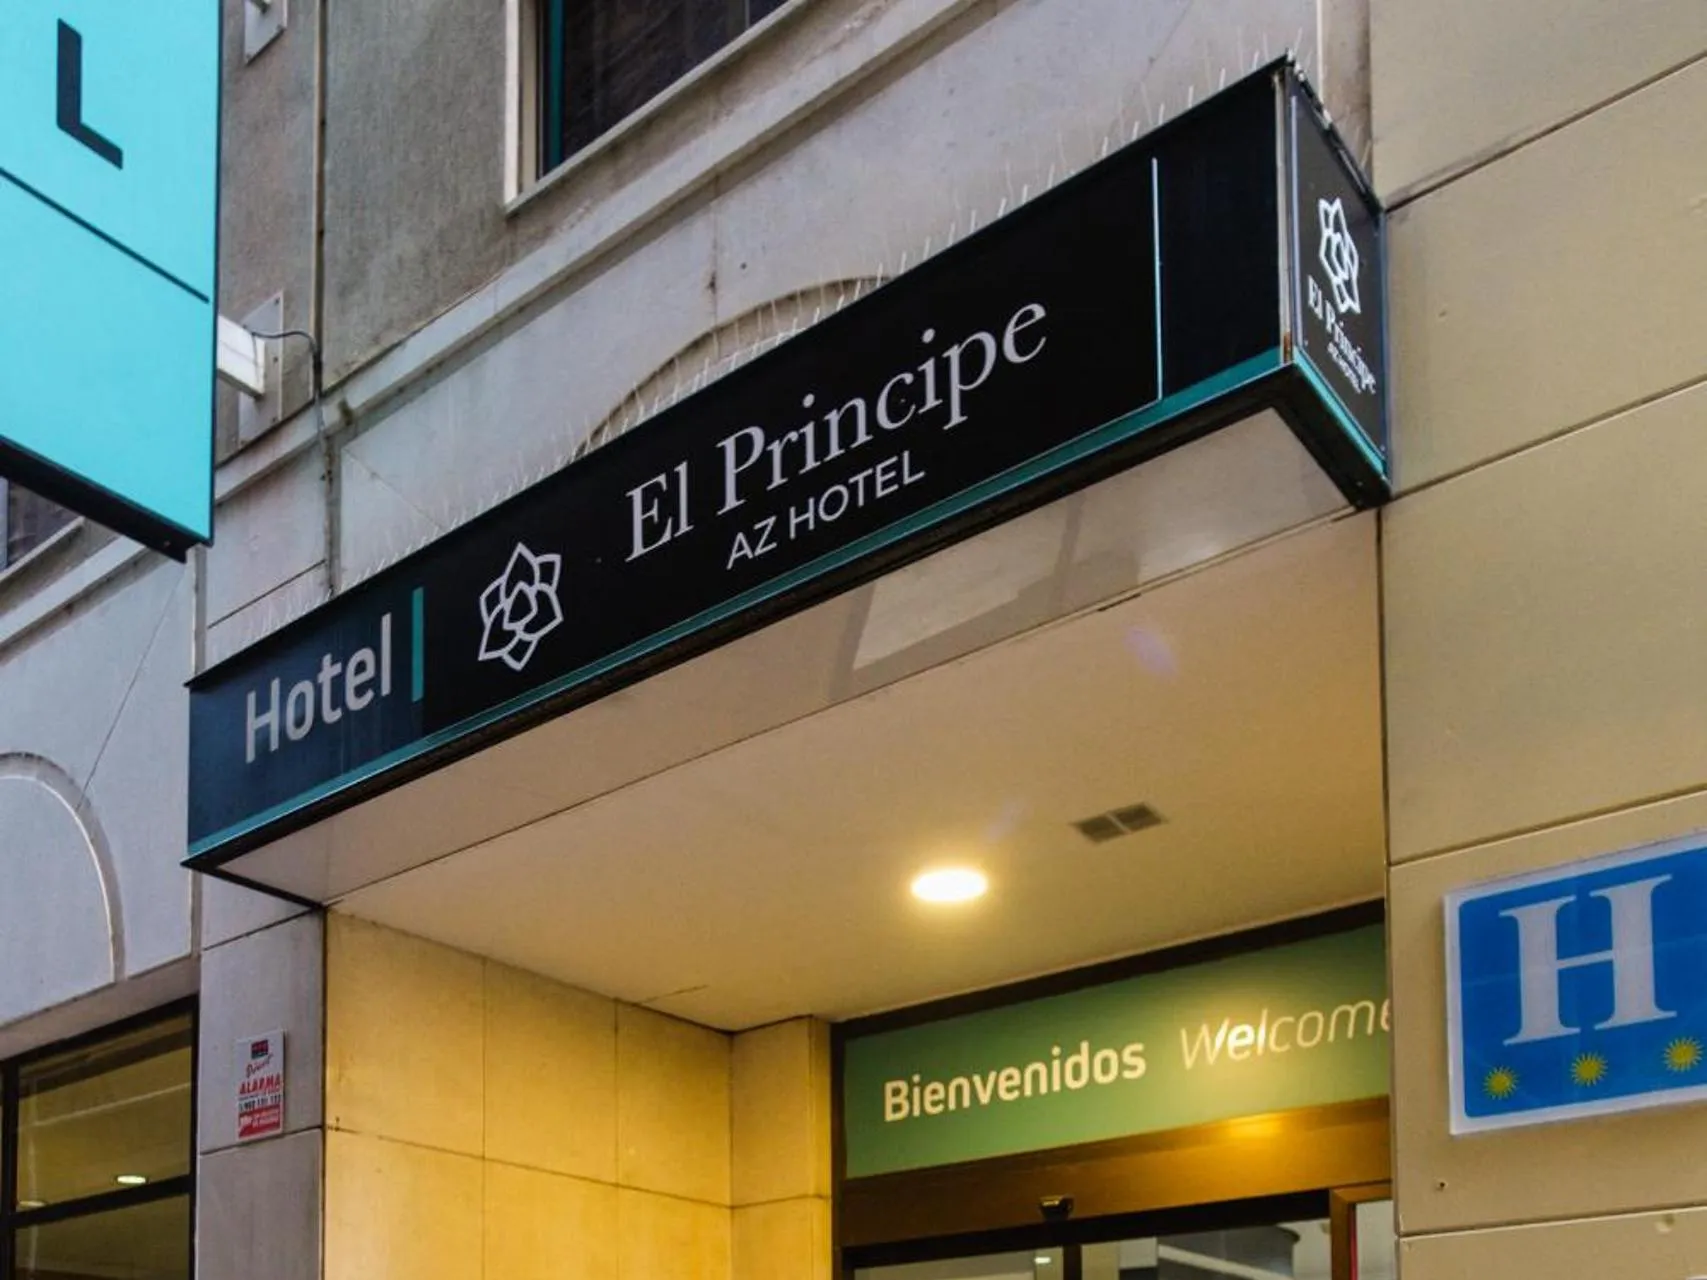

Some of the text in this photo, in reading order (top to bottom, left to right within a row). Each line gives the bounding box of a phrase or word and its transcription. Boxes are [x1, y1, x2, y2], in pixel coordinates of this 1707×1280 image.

[56, 18, 123, 170] L
[1307, 274, 1323, 320] El
[625, 303, 1046, 562] El Principe
[726, 450, 925, 569] AZ HOTEL
[246, 613, 392, 763] Hotel
[1499, 875, 1678, 1046] H
[239, 1073, 281, 1095] ALARMA
[884, 1040, 1147, 1122] Bienvenidos
